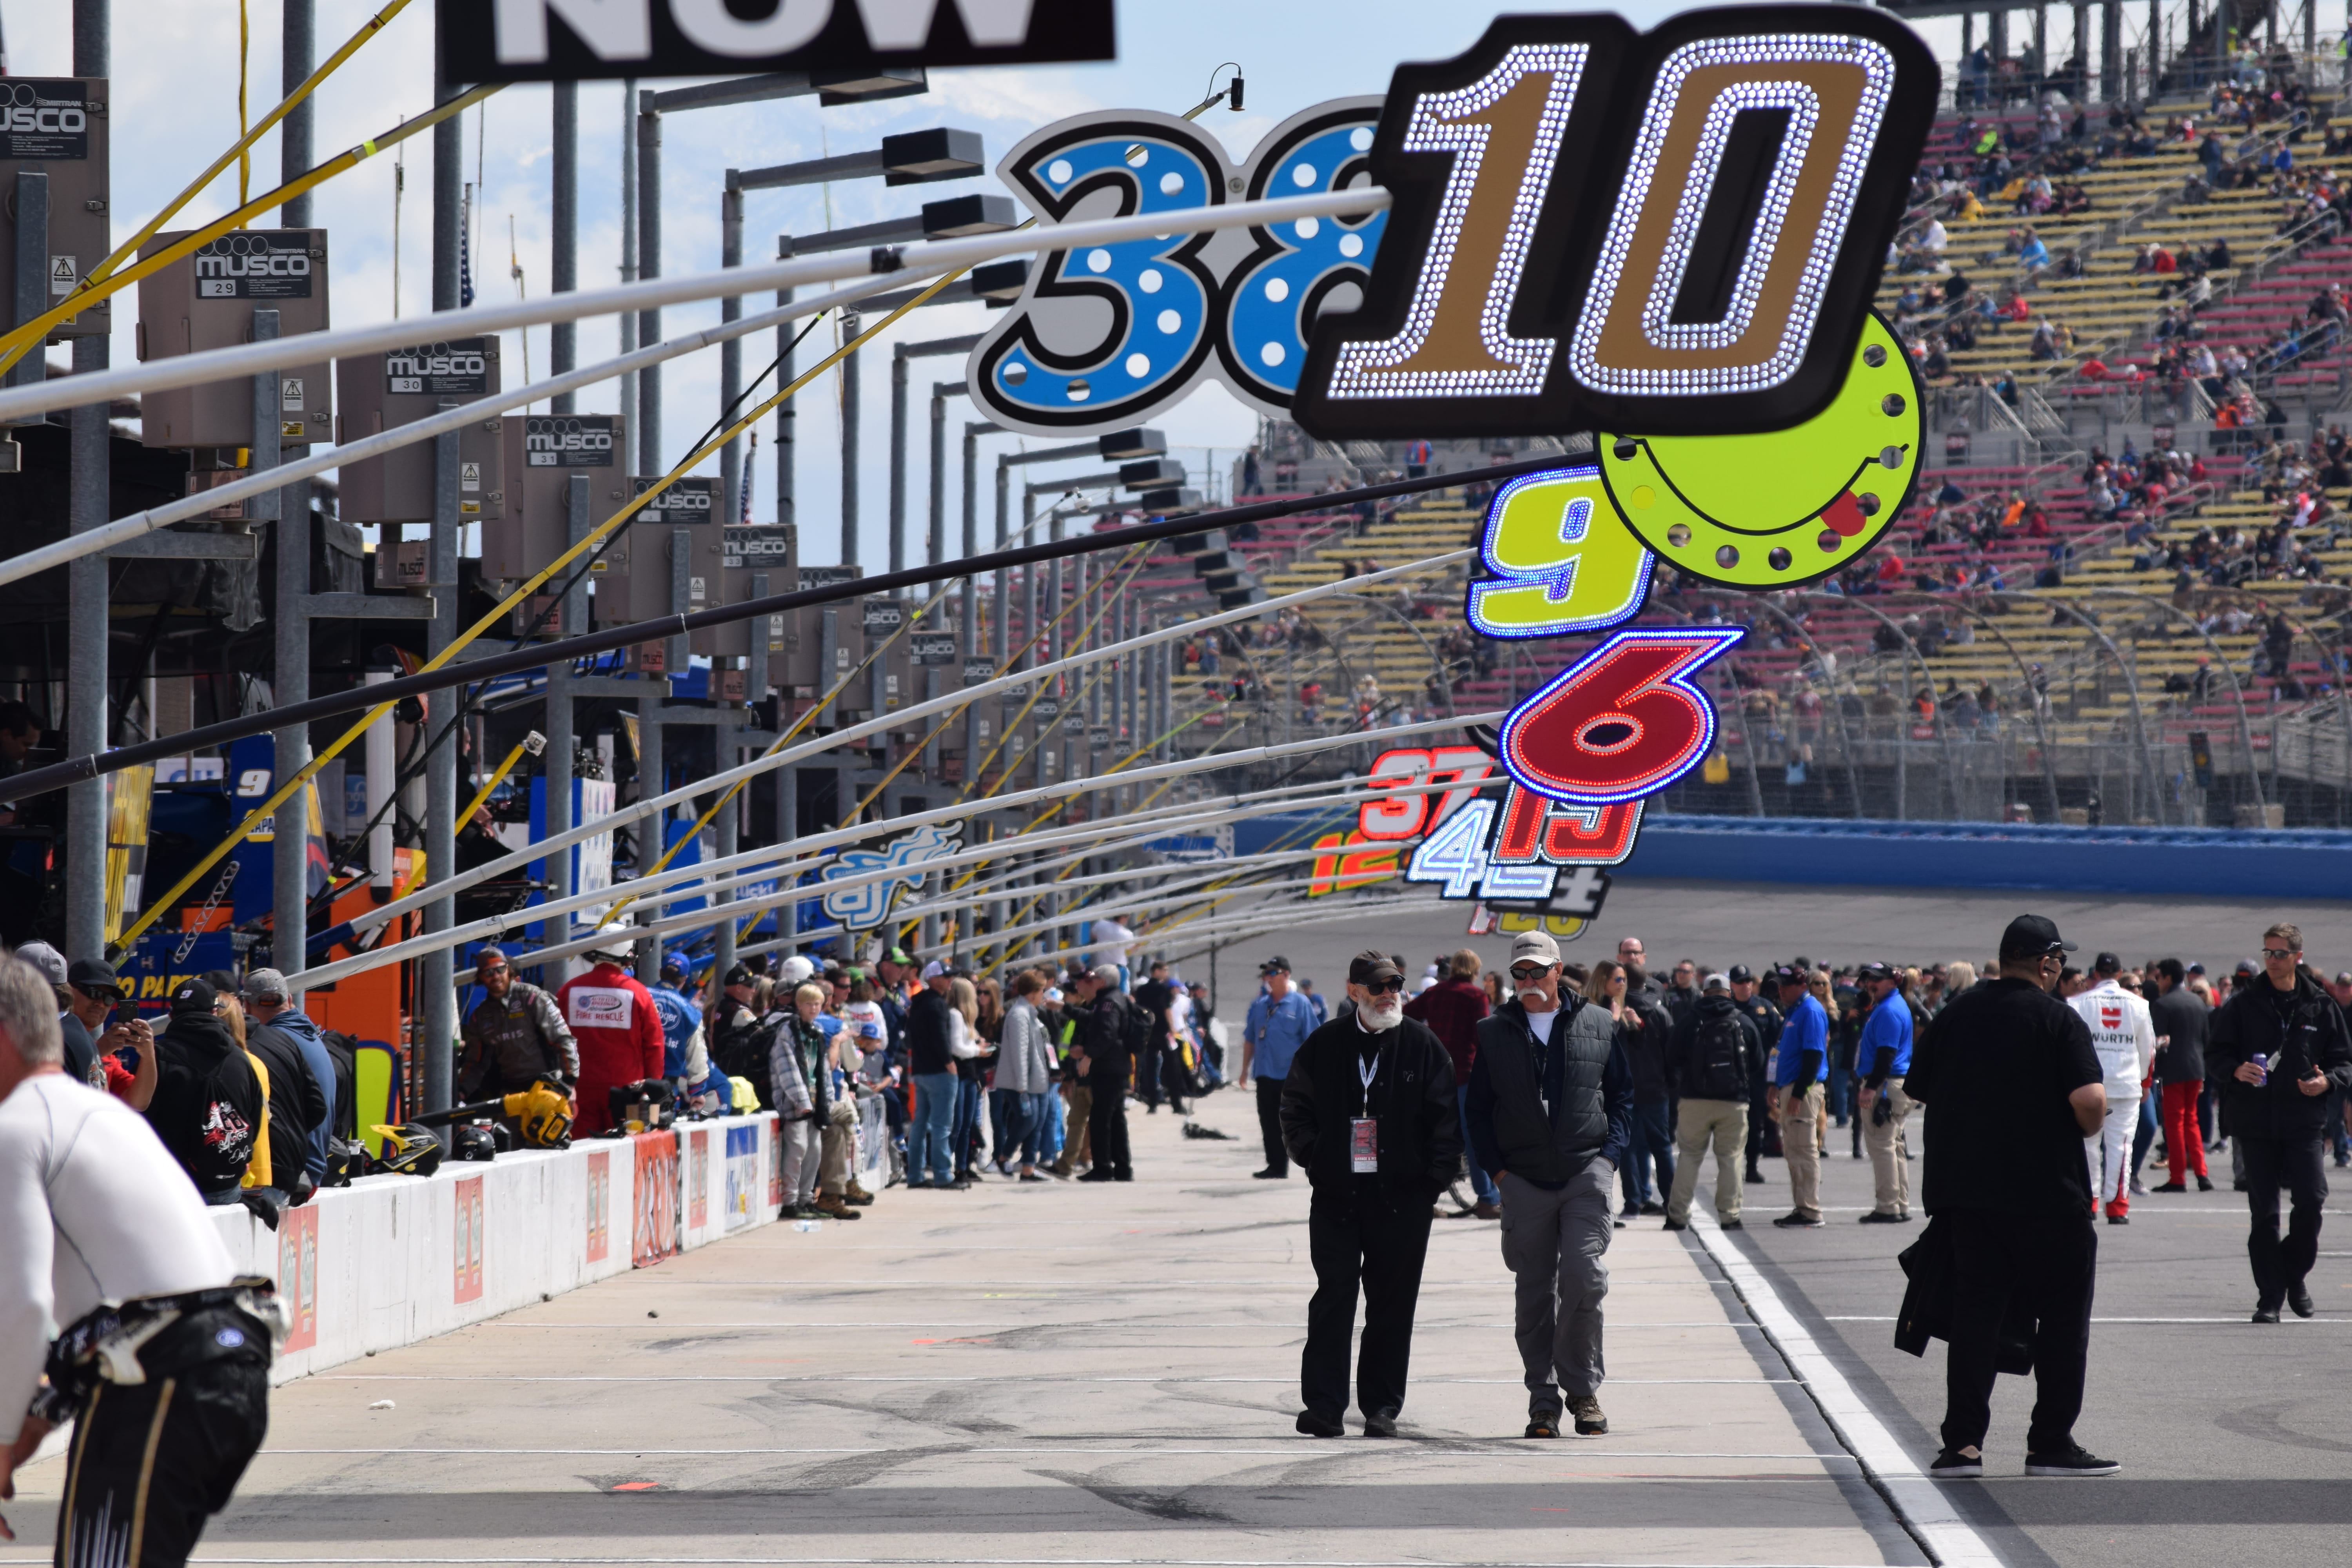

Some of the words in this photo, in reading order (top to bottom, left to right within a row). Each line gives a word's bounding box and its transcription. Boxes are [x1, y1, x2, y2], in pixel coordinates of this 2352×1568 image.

[0, 107, 86, 132] USCO
[1326, 33, 1897, 399] 10
[976, 107, 1384, 428] 38
[635, 495, 711, 509] USCO
[1468, 464, 1655, 637] 9
[1500, 629, 1744, 804] 6
[236, 769, 272, 798] 9
[1359, 746, 1495, 840] 37
[1307, 828, 1401, 898] 12
[179, 989, 194, 999] 9
[576, 1011, 592, 1020] FIRE
[595, 1011, 624, 1022] RESCUE
